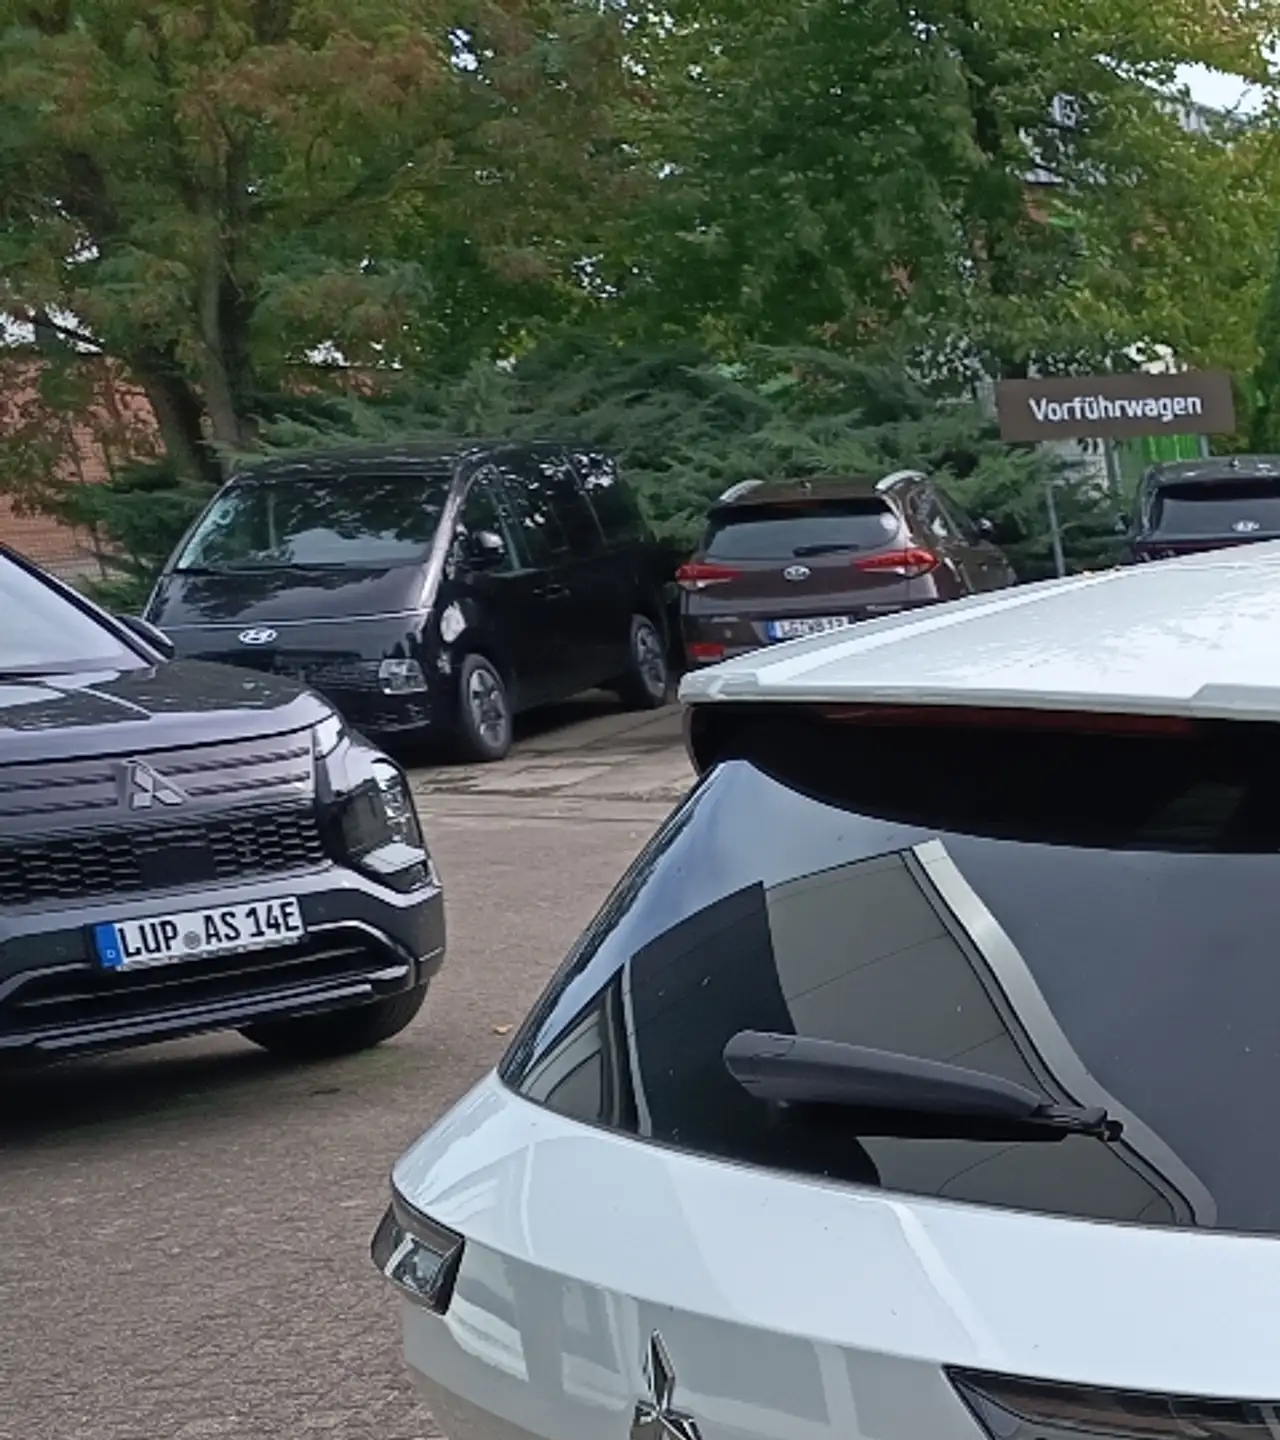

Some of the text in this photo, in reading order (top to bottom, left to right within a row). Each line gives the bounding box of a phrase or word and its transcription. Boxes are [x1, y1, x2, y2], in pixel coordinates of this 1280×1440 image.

[1029, 395, 1202, 422] Vorführwagen
[117, 920, 179, 958] LUP
[203, 911, 242, 945] AS
[245, 901, 300, 938] 14E
